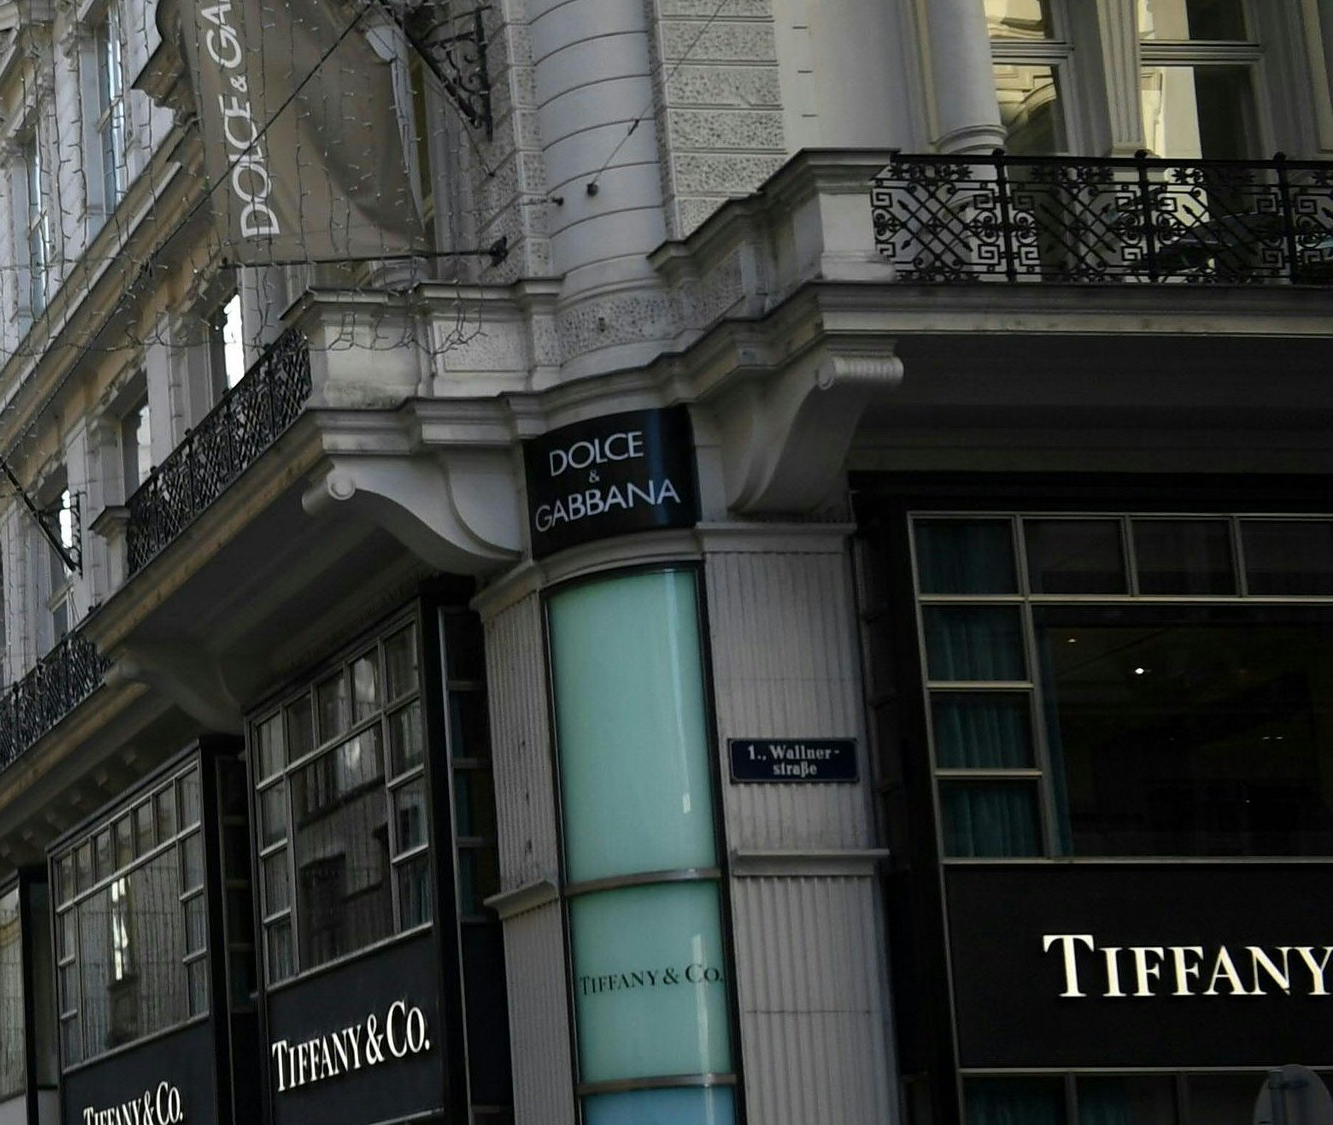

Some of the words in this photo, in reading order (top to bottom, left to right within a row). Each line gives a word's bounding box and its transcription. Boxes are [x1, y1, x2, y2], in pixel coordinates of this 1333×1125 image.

[230, 75, 247, 93] &
[219, 95, 280, 238] DOLCE
[548, 430, 644, 475] DOLCE
[588, 470, 600, 484] &
[535, 478, 681, 534] GABBANA
[746, 745, 768, 761] 1.,
[769, 744, 840, 760] Wallner-
[773, 761, 818, 778] straße
[579, 970, 659, 996] TIFFANY
[662, 966, 679, 985] &
[1043, 934, 1333, 998] TIFFANY
[271, 1024, 363, 1092] TIFFANY
